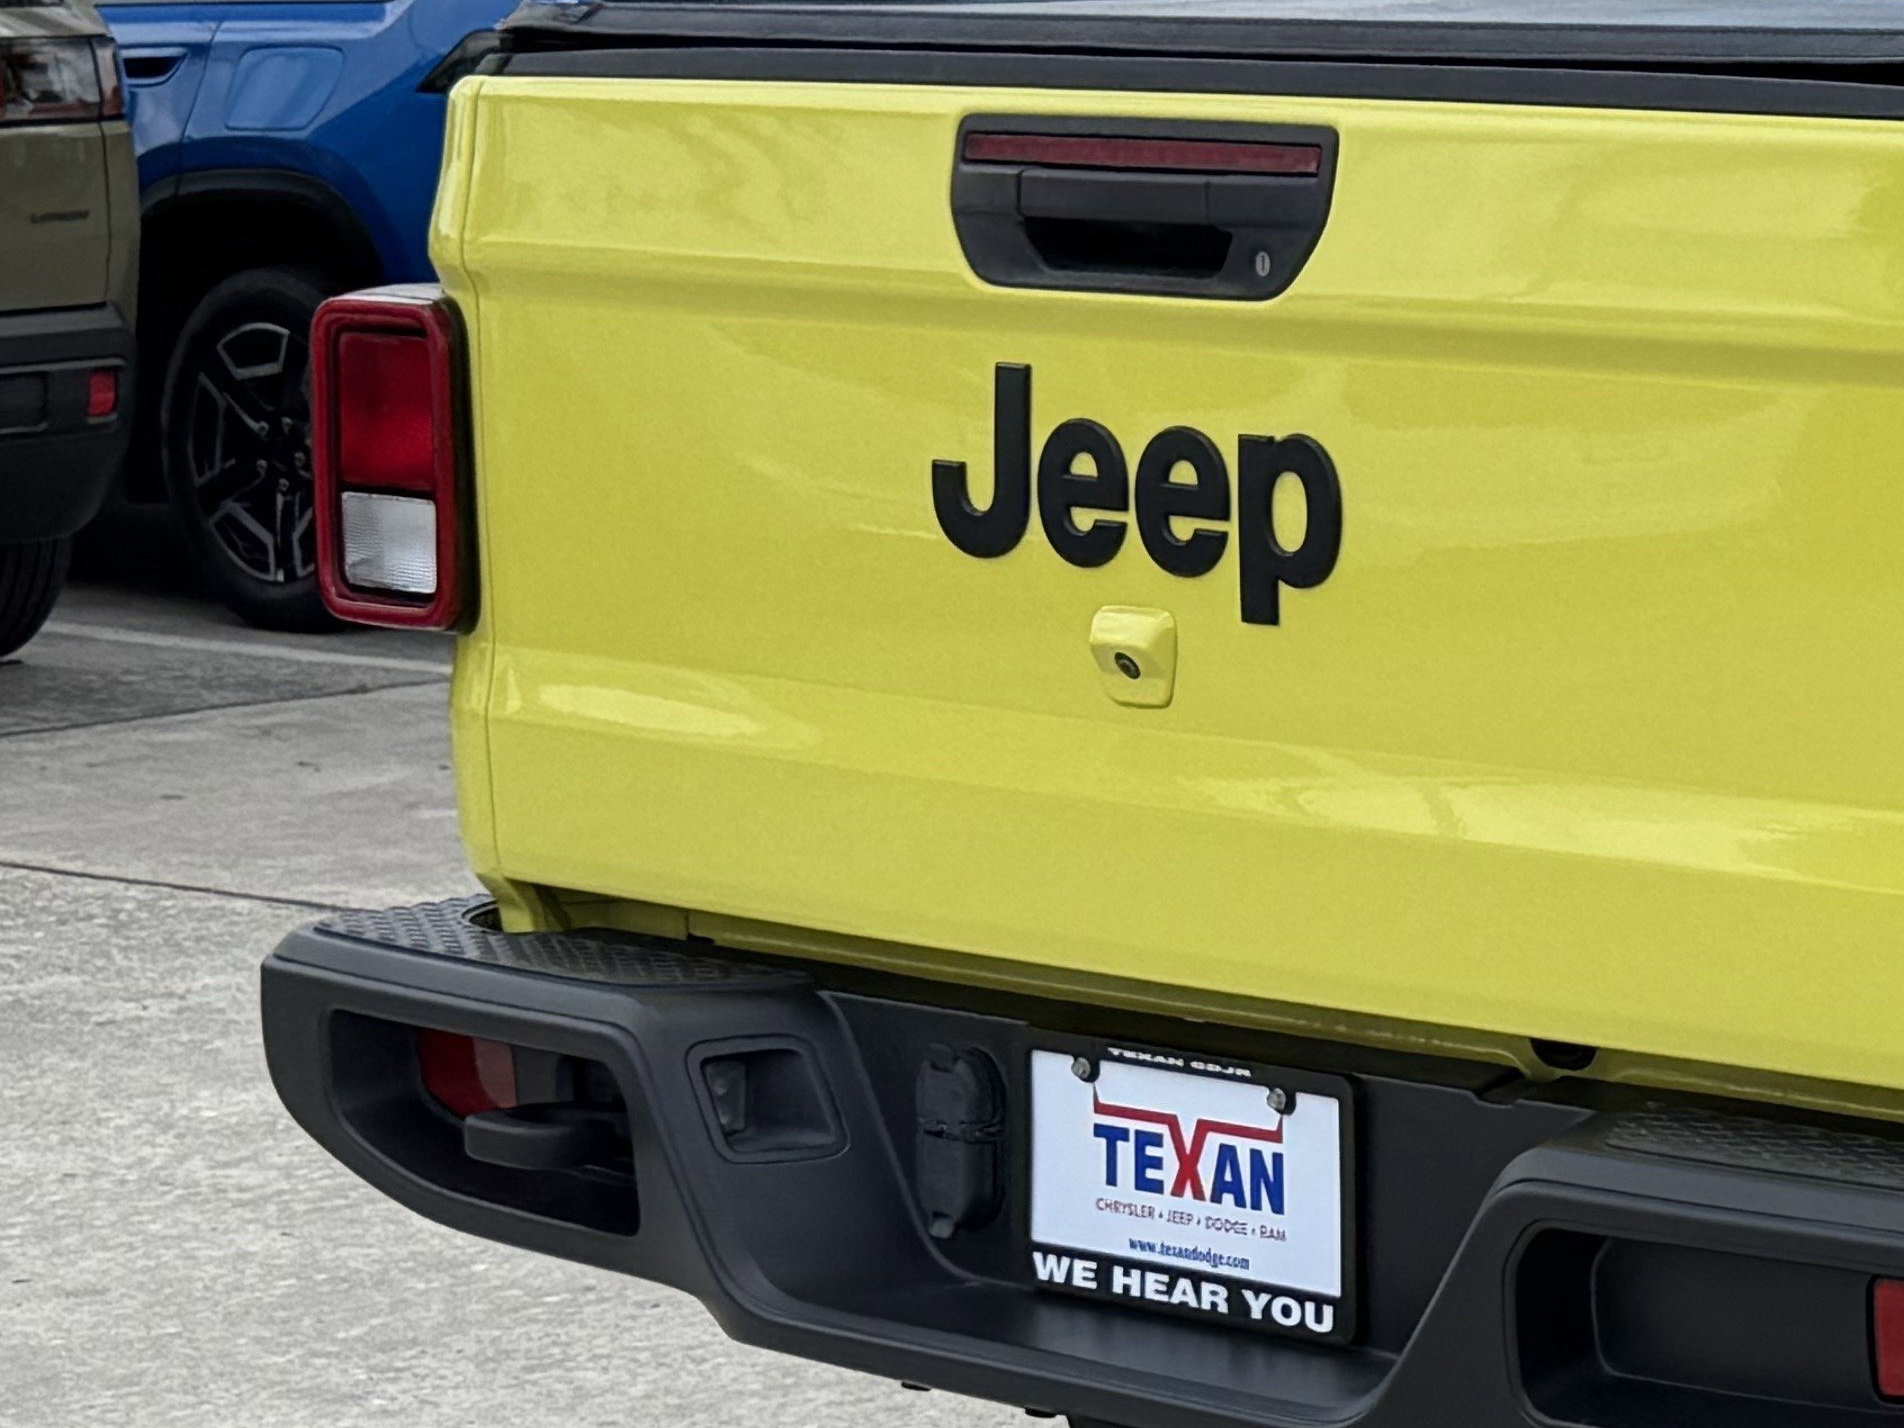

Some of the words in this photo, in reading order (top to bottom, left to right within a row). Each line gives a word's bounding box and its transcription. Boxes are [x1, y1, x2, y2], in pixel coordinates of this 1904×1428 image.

[931, 362, 1343, 626] Jeep
[1107, 1047, 1185, 1068] TEXAN
[1093, 1104, 1284, 1215] TEXAN
[1096, 1198, 1155, 1219] CHRYSLER
[1166, 1210, 1194, 1226] JEEP
[1205, 1216, 1248, 1236] DODGE
[1259, 1225, 1287, 1242] RAM
[1129, 1238, 1250, 1271] www.texandodge.com
[1032, 1252, 1097, 1289] WE
[1112, 1266, 1228, 1314] HEAR
[1242, 1288, 1334, 1334] YOU
